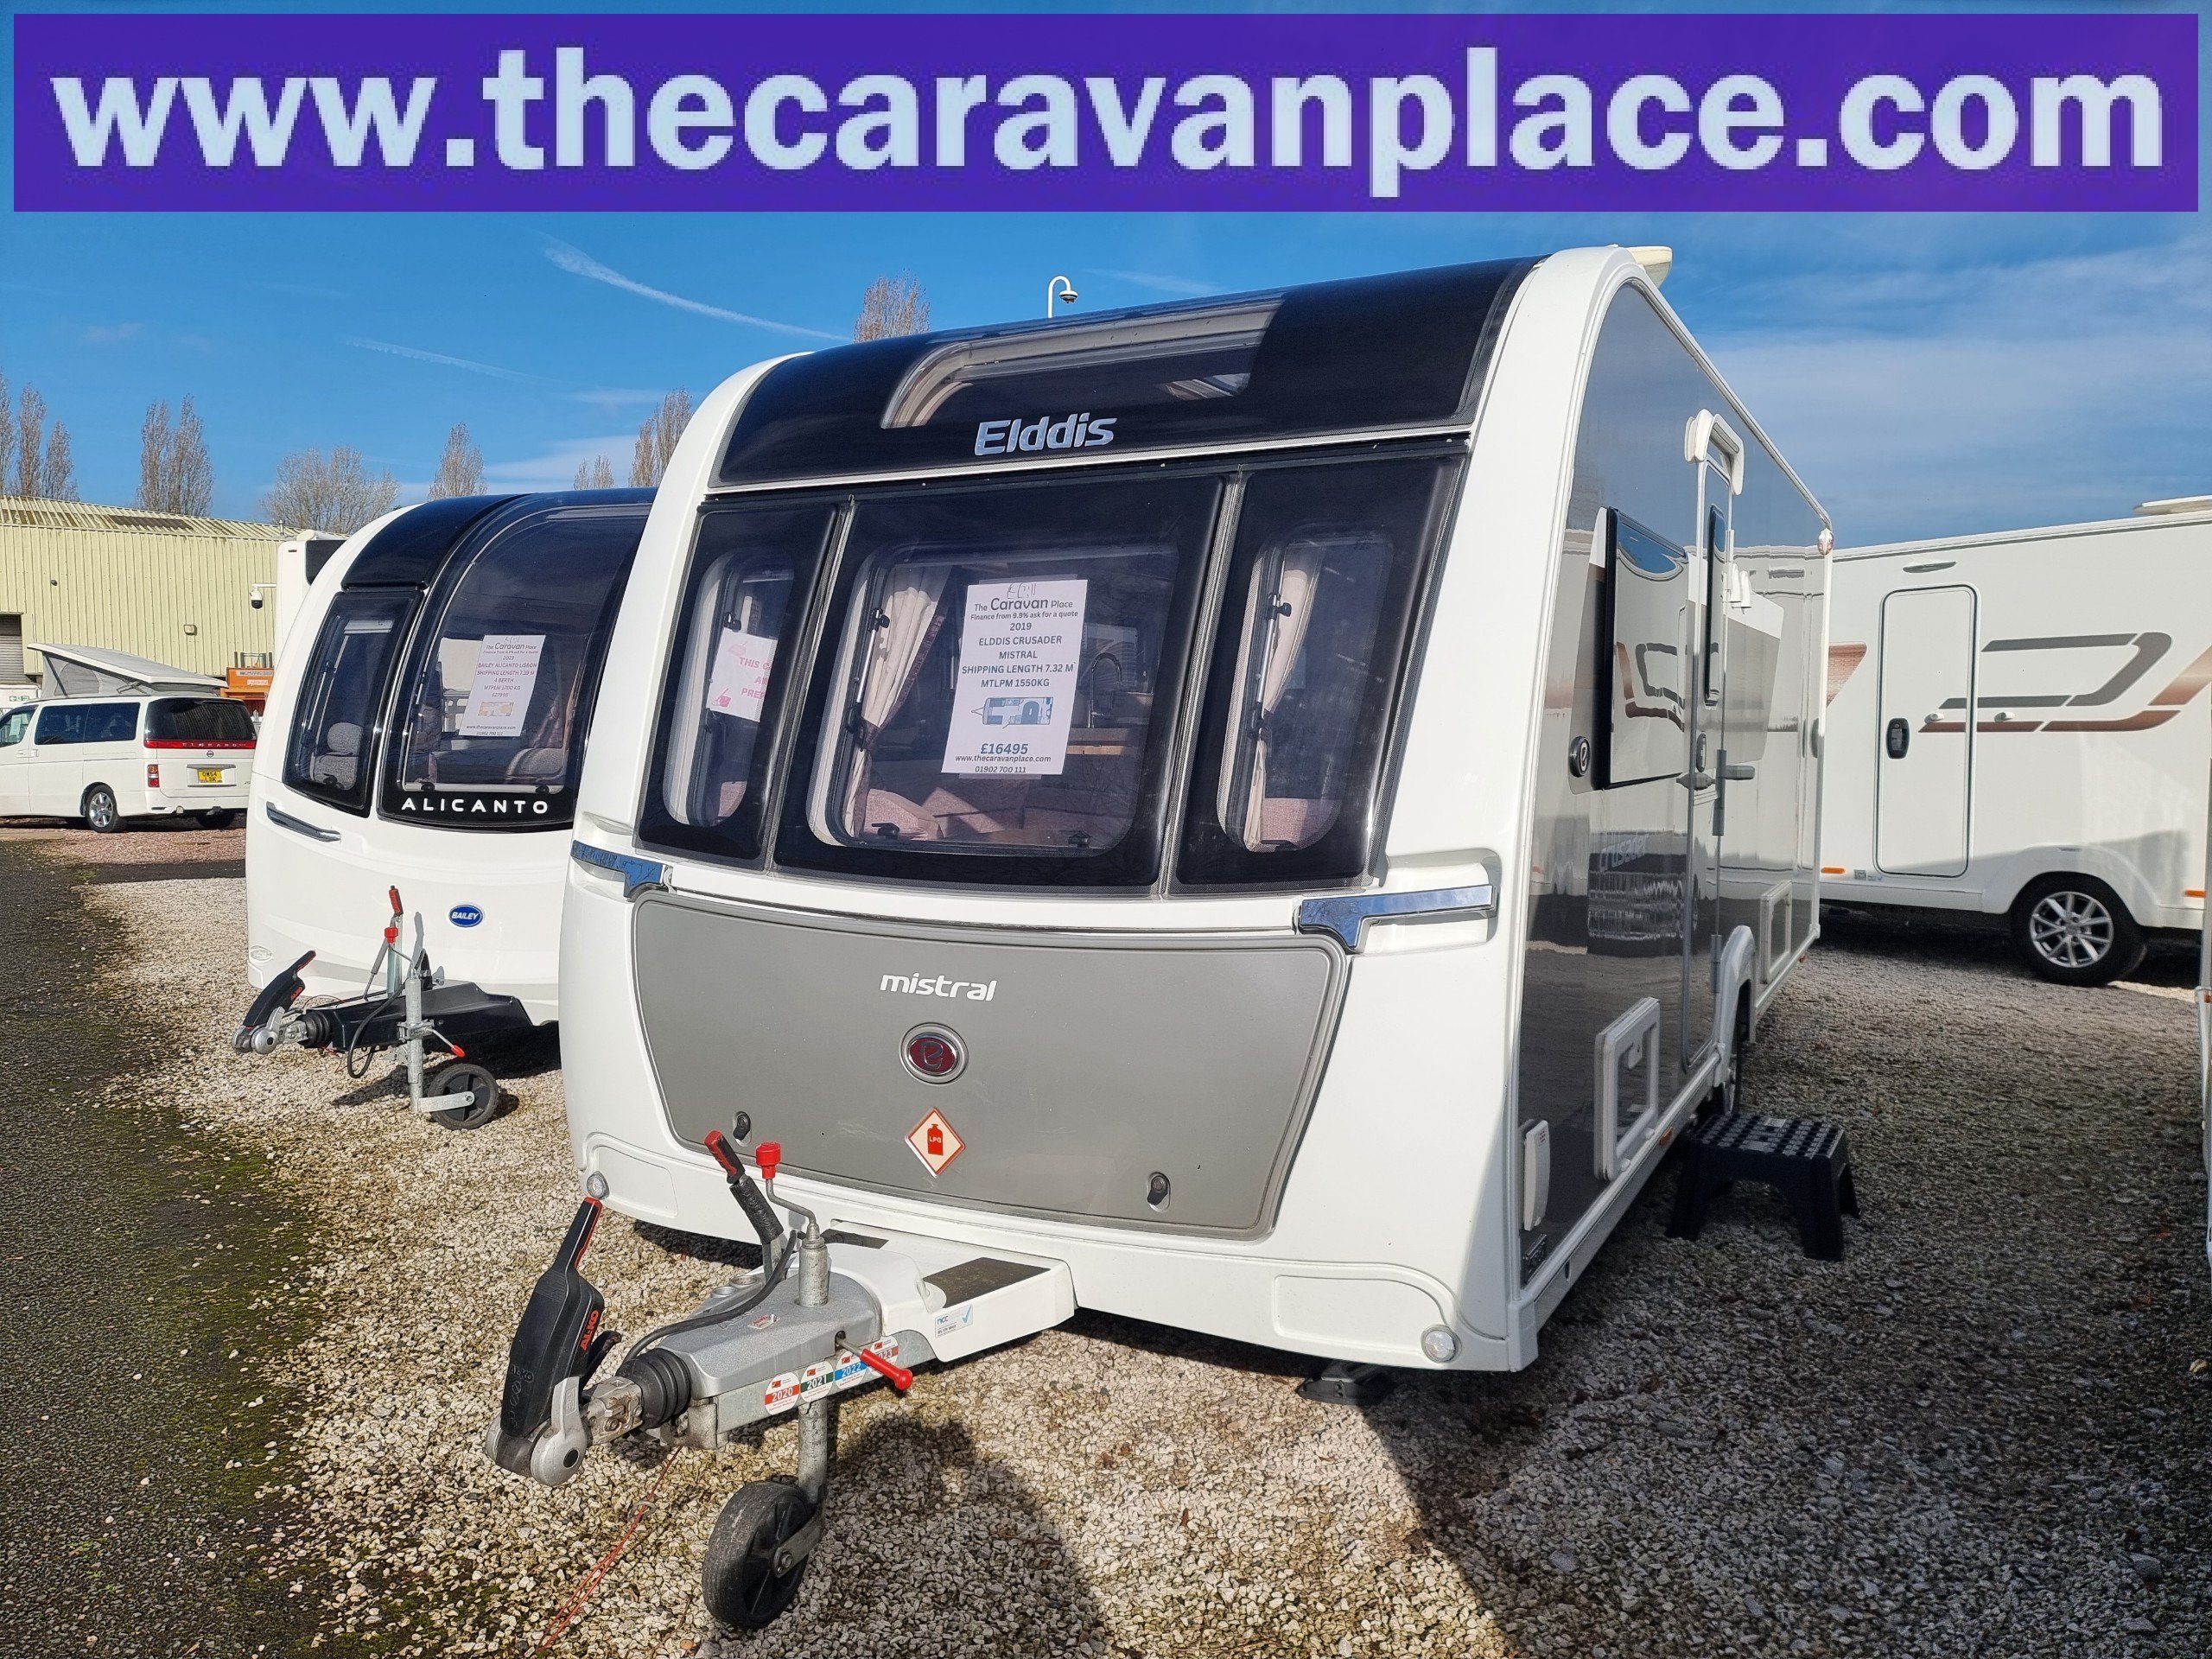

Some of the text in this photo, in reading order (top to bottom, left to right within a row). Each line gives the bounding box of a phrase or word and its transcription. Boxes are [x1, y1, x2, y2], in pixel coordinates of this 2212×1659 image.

[974, 412, 1117, 456] Elddis
[974, 597, 1073, 612] The Caravan Place
[1009, 622, 1032, 631] 2019
[978, 635, 1062, 646] ELDDIS CRUSADER
[999, 651, 1038, 659] MISTRAL
[739, 657, 760, 669] THIS
[962, 664, 1074, 674] SHIPPING LENGTH 7.32 M
[981, 679, 1014, 688] MTLPM
[980, 743, 1028, 754] £16495
[955, 754, 1052, 763] www.thecaravanplace.com
[401, 798, 548, 814] ALICANTO
[451, 912, 479, 920] BAILEY
[880, 972, 997, 1001] mistral
[929, 1135, 942, 1143] LPG
[842, 1362, 861, 1377] 2022
[807, 1374, 827, 1390] 2021
[772, 1387, 793, 1402] 2020
